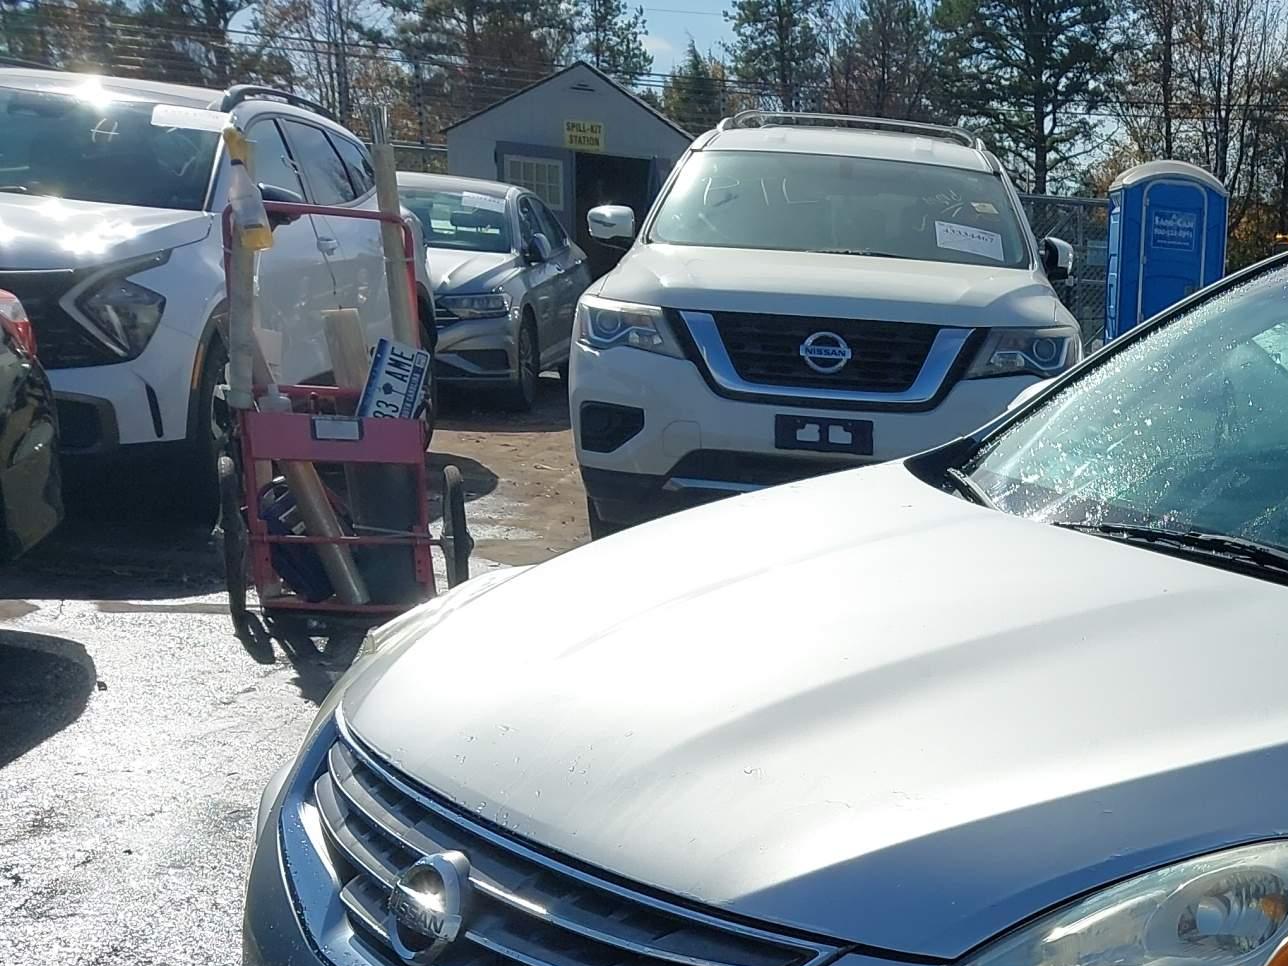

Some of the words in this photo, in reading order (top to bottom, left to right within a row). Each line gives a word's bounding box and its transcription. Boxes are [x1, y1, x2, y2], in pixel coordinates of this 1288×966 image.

[566, 121, 602, 134] SPILL-KIT
[567, 134, 600, 147] STATION
[805, 347, 846, 357] NISSAN
[384, 346, 415, 384] AME
